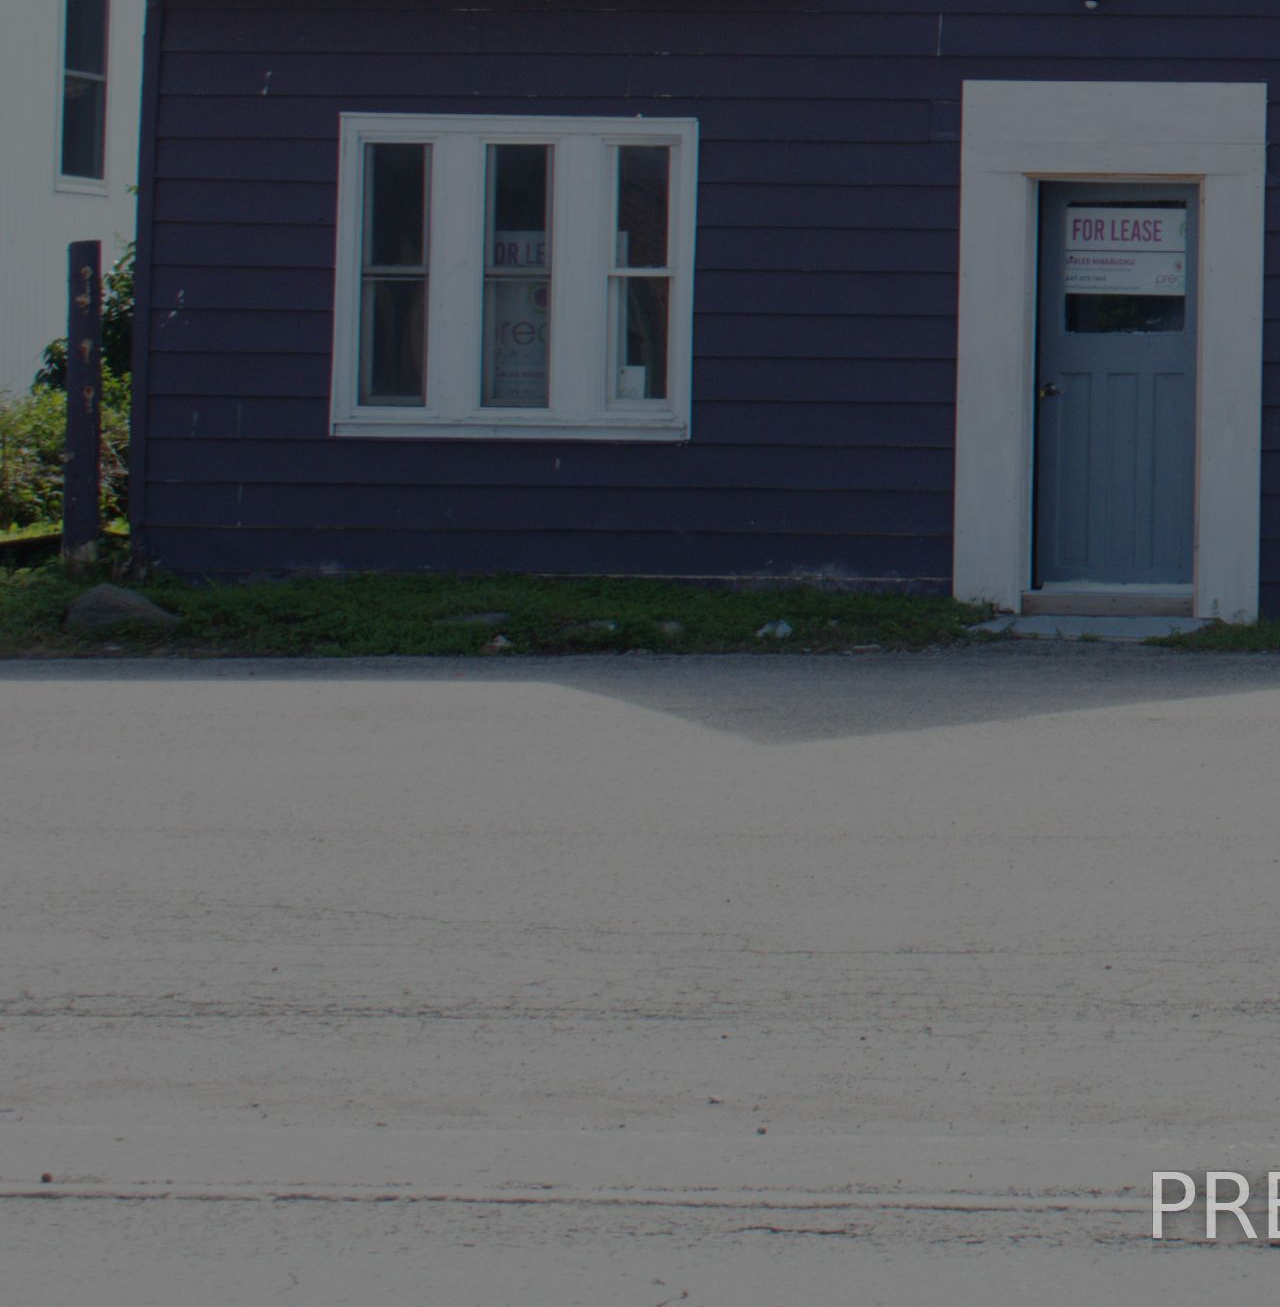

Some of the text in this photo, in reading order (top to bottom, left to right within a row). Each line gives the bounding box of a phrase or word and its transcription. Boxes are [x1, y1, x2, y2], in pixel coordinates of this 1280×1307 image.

[1072, 218, 1162, 242] FOR LEASE
[495, 242, 518, 265] OR
